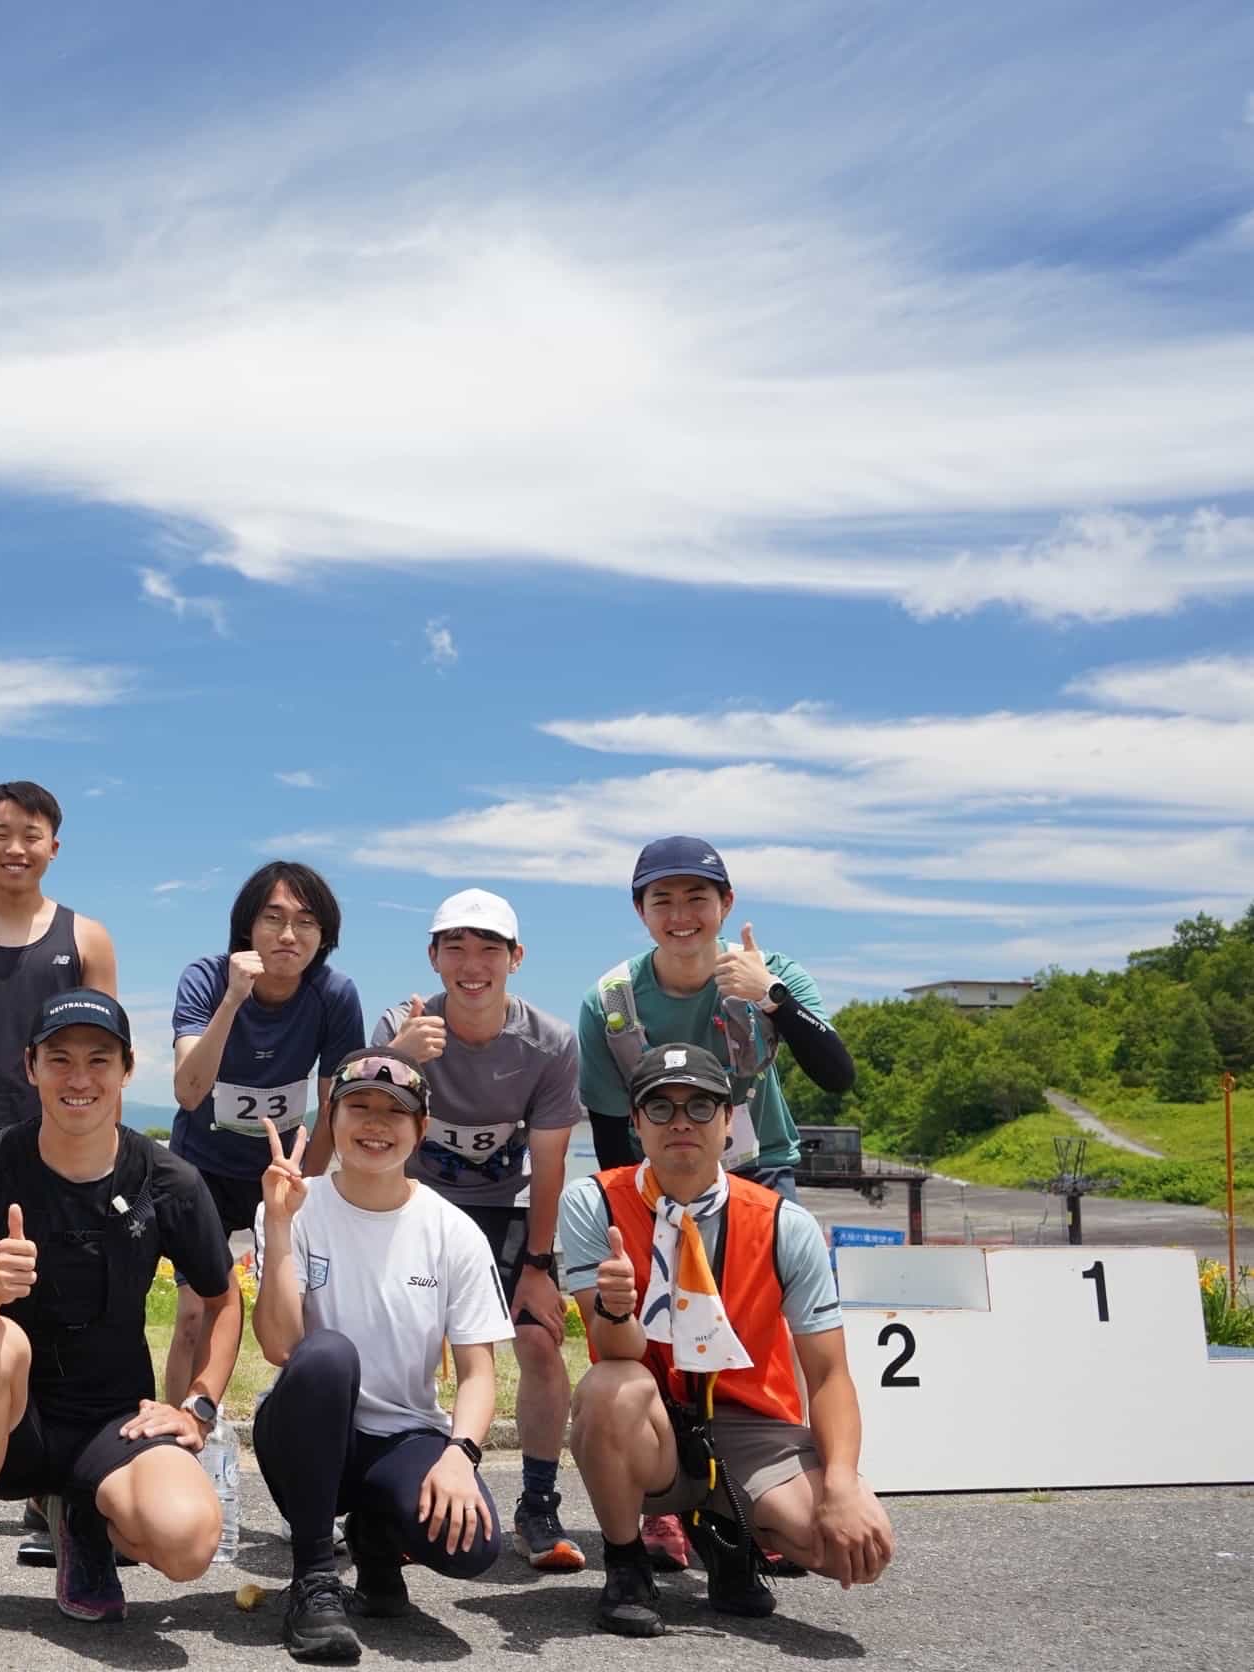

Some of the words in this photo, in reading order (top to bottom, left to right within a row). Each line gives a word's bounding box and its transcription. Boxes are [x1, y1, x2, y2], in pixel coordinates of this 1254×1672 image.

[237, 1094, 287, 1119] 23
[443, 1129, 496, 1151] 18
[1082, 1260, 1110, 1322] 1
[877, 1322, 921, 1387] 2
